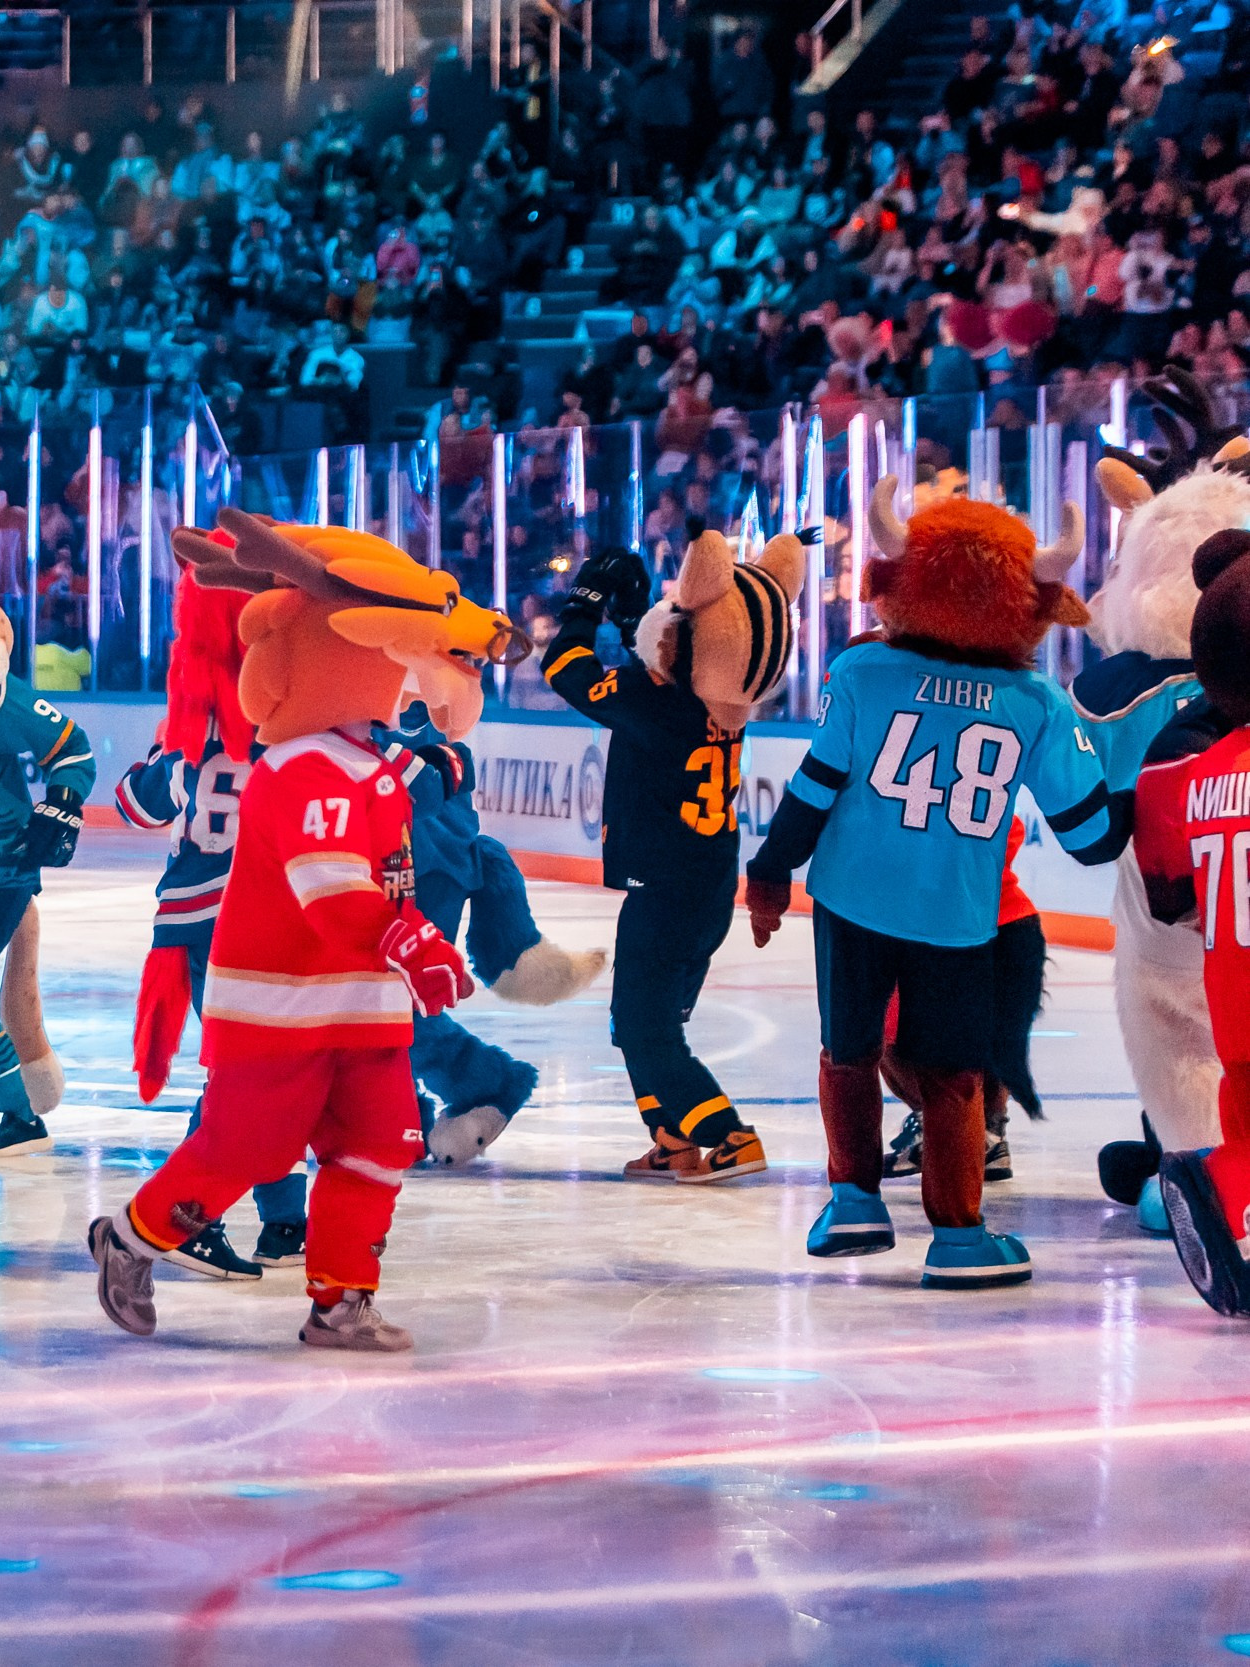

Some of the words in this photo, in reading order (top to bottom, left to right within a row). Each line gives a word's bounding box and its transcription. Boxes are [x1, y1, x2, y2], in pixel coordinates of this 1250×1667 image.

[33, 698, 62, 723] 9
[816, 692, 833, 728] 8
[914, 672, 993, 712] ZUBR
[1073, 726, 1097, 757] 4
[476, 757, 573, 820] АЛТИКА
[867, 709, 1022, 841] 48
[169, 752, 252, 857] 6
[302, 797, 350, 841] 47
